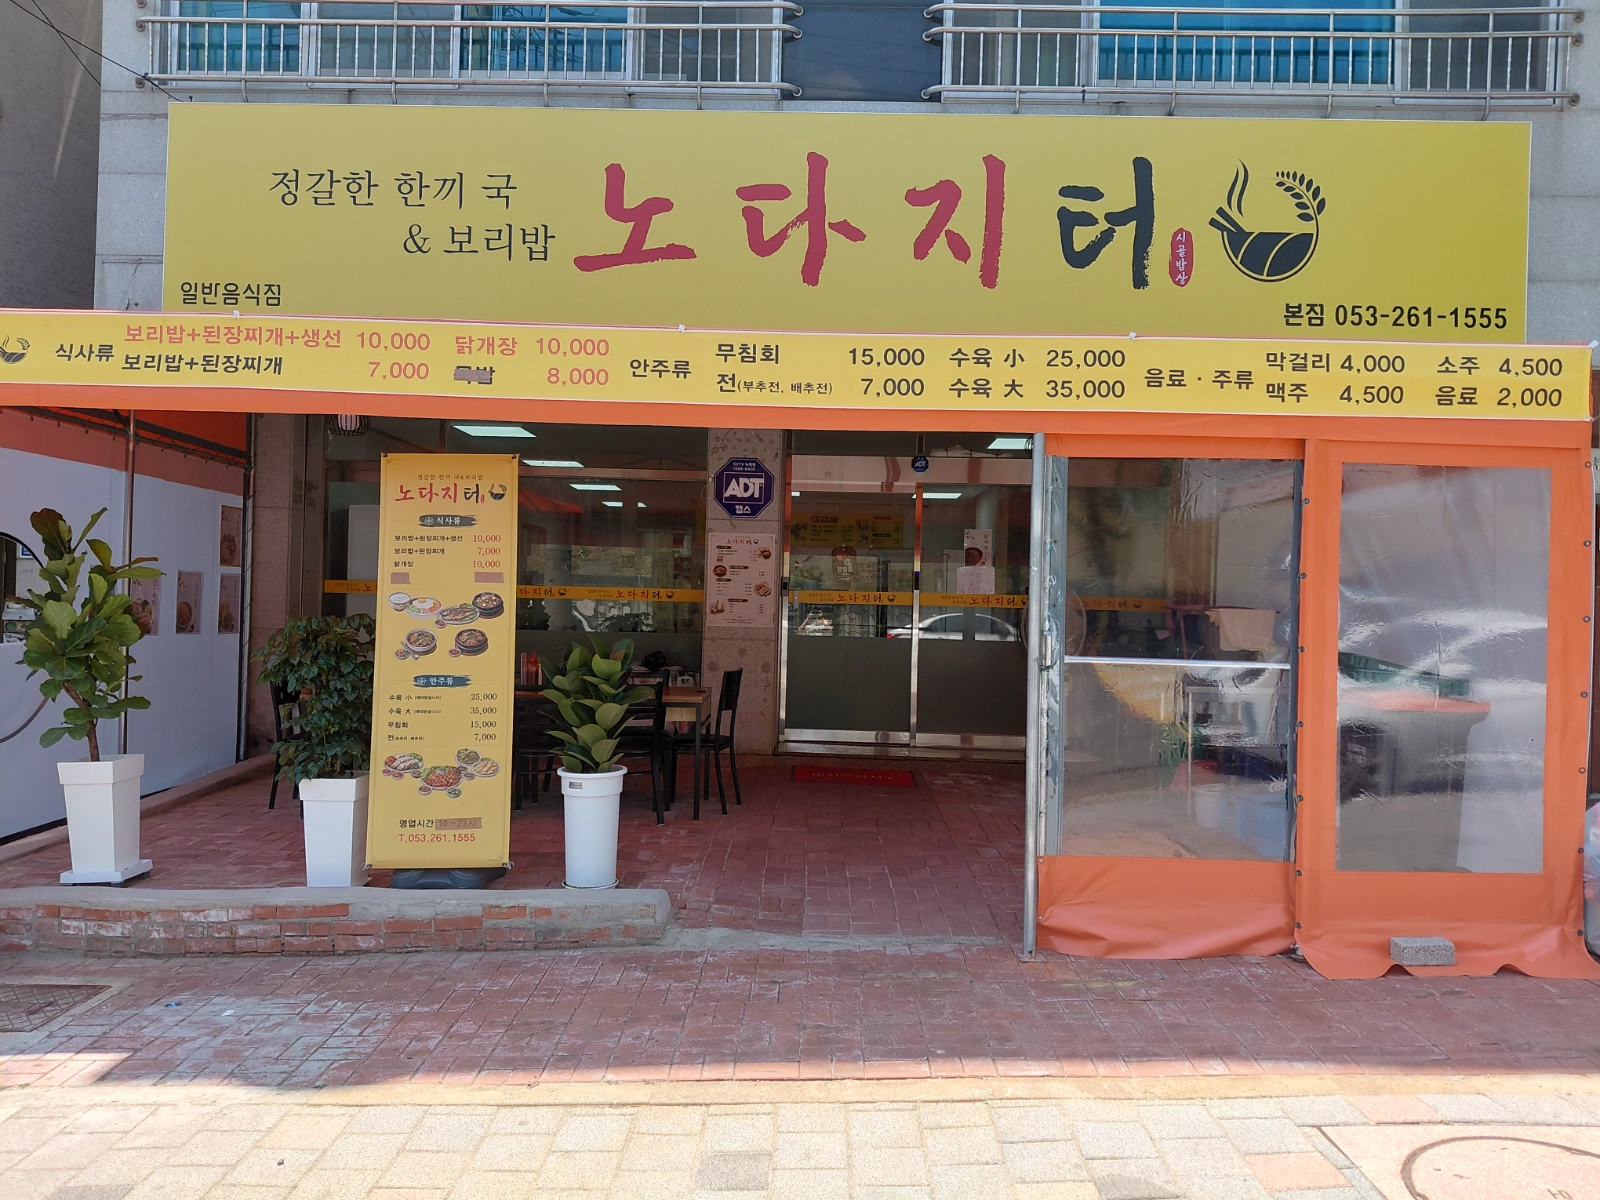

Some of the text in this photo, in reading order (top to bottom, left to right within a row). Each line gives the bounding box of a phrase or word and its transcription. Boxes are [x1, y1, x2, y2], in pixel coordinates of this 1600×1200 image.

[268, 168, 518, 210] 정갈한 한끼 국
[574, 152, 1155, 290] 노다지터
[403, 223, 556, 262] & 보리밥
[1174, 230, 1189, 286] 시골밥상
[180, 281, 281, 307] 일반음식점
[1334, 304, 1507, 330] 053-261-1555
[124, 324, 431, 352] 보리밥+된장찌개+생선 10,000
[455, 335, 610, 358] 닭개장 10,000
[54, 343, 115, 363] 식사류
[715, 343, 925, 368] 무침회 15,000
[948, 347, 1126, 370] 수육 小 25,000
[1265, 351, 1406, 375] 막걸리 4,000
[121, 353, 430, 381] 보리밥+된장찌개 7,000
[546, 367, 610, 387] 8,000
[629, 358, 692, 380] 안주류
[1436, 356, 1563, 378] 소주 4,500
[716, 372, 832, 395] 전(부추전, 배추전)
[860, 377, 925, 399] 7,000
[948, 377, 1126, 401] 수육 大 35,000
[1144, 367, 1187, 388] 음료
[1211, 369, 1255, 391] 주류
[1265, 382, 1404, 406] 맥주 4,500
[1434, 385, 1563, 409] 음료 2,000
[394, 482, 479, 504] 노다지터
[724, 477, 764, 498] ADT
[436, 516, 461, 526] 식사류
[472, 534, 501, 544] 10,000
[477, 547, 501, 557] 7,000
[472, 560, 501, 570] 10,000
[519, 586, 552, 598] 다지터
[615, 588, 661, 601] 노다지터
[836, 592, 882, 604] 노다지터
[968, 595, 1016, 607] 노다지터
[428, 676, 455, 687] 안주류
[388, 694, 403, 702] 수육
[470, 692, 498, 702] 25,000
[388, 707, 402, 715] 수육
[470, 706, 498, 716] 35,000
[470, 720, 497, 730] 15,000
[474, 733, 497, 742] 7,000
[399, 818, 437, 829] 영업시간
[398, 833, 476, 843] T.053.261.1555
